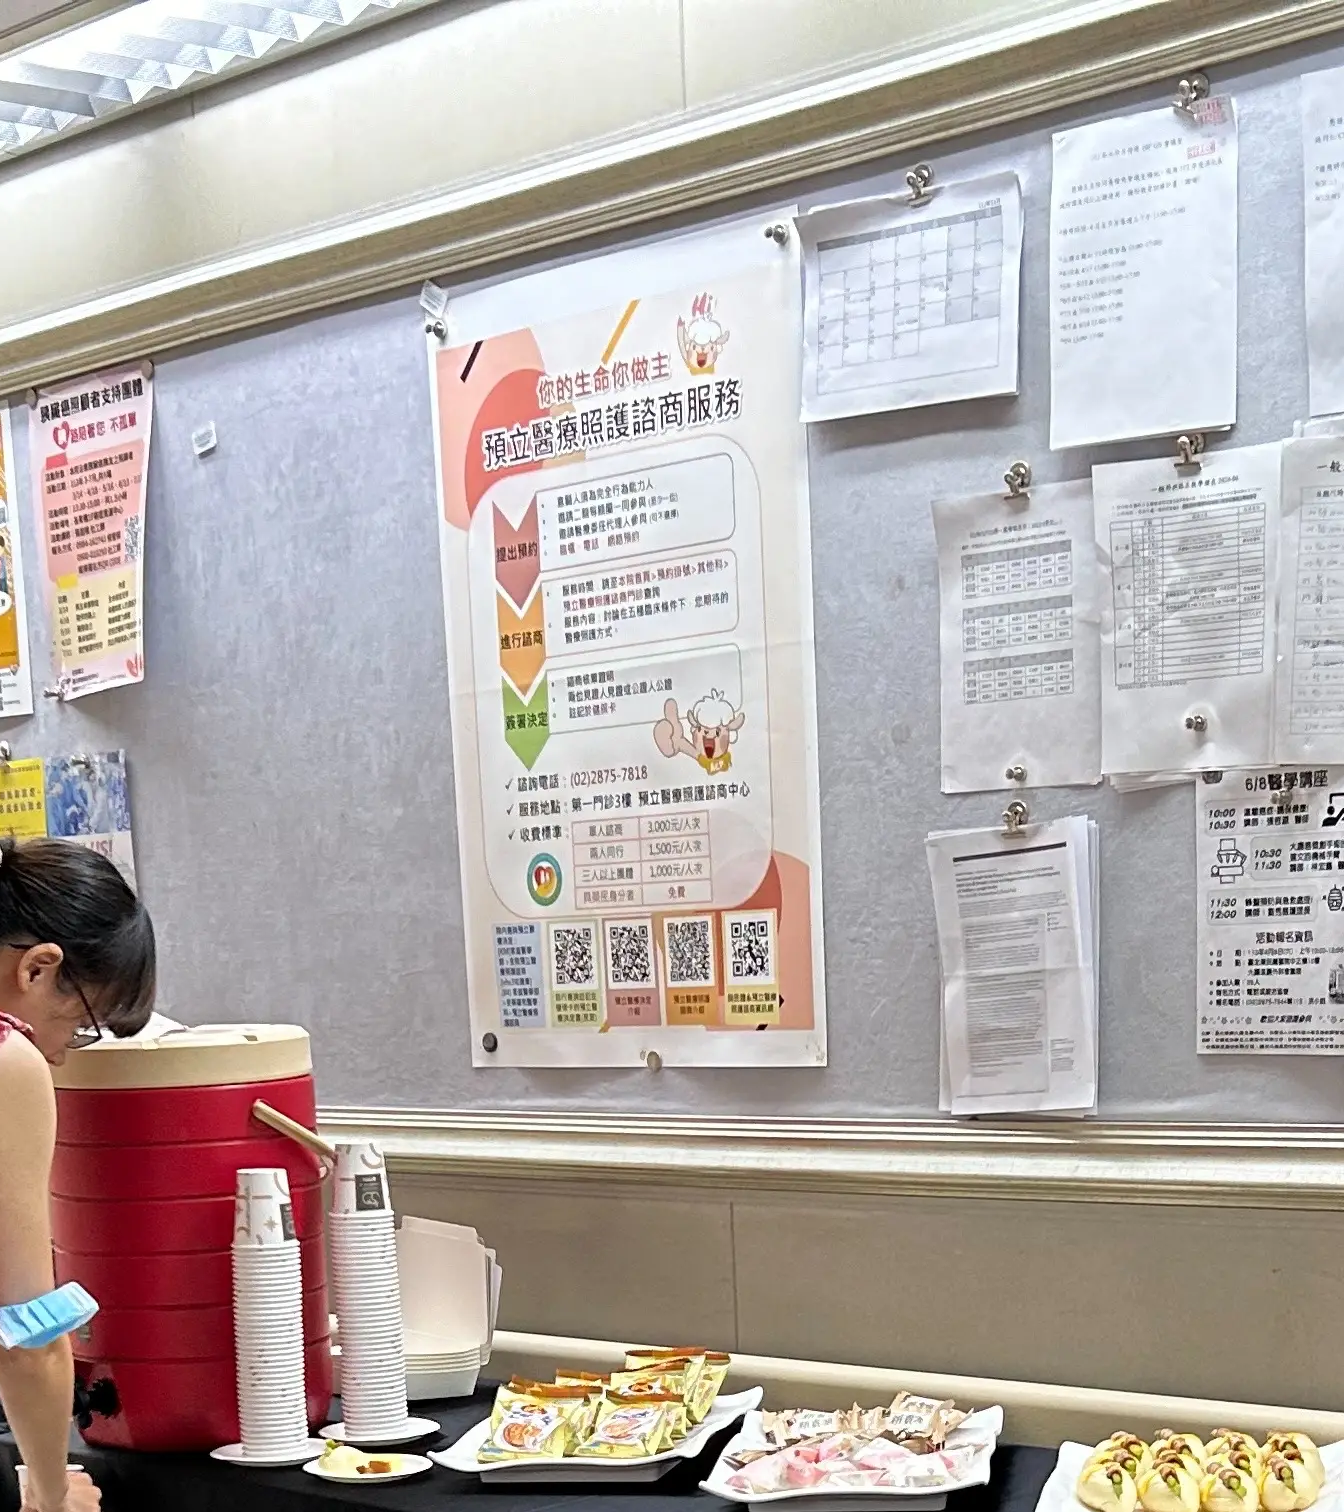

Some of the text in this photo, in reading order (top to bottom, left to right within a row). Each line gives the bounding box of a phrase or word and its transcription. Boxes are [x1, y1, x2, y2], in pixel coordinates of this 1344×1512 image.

[539, 352, 670, 406] 你的生命你做主
[484, 378, 742, 467] 預立醫療照護諮商服務
[570, 765, 648, 789] (02)2875-7818
[1208, 808, 1236, 818] 10:00
[1208, 820, 1236, 830] 10:30
[1254, 849, 1282, 859] 10:30
[1254, 861, 1282, 871] 11:30
[668, 886, 686, 899] 免費
[1210, 898, 1237, 908] 11:30
[1210, 910, 1237, 919] 12:00
